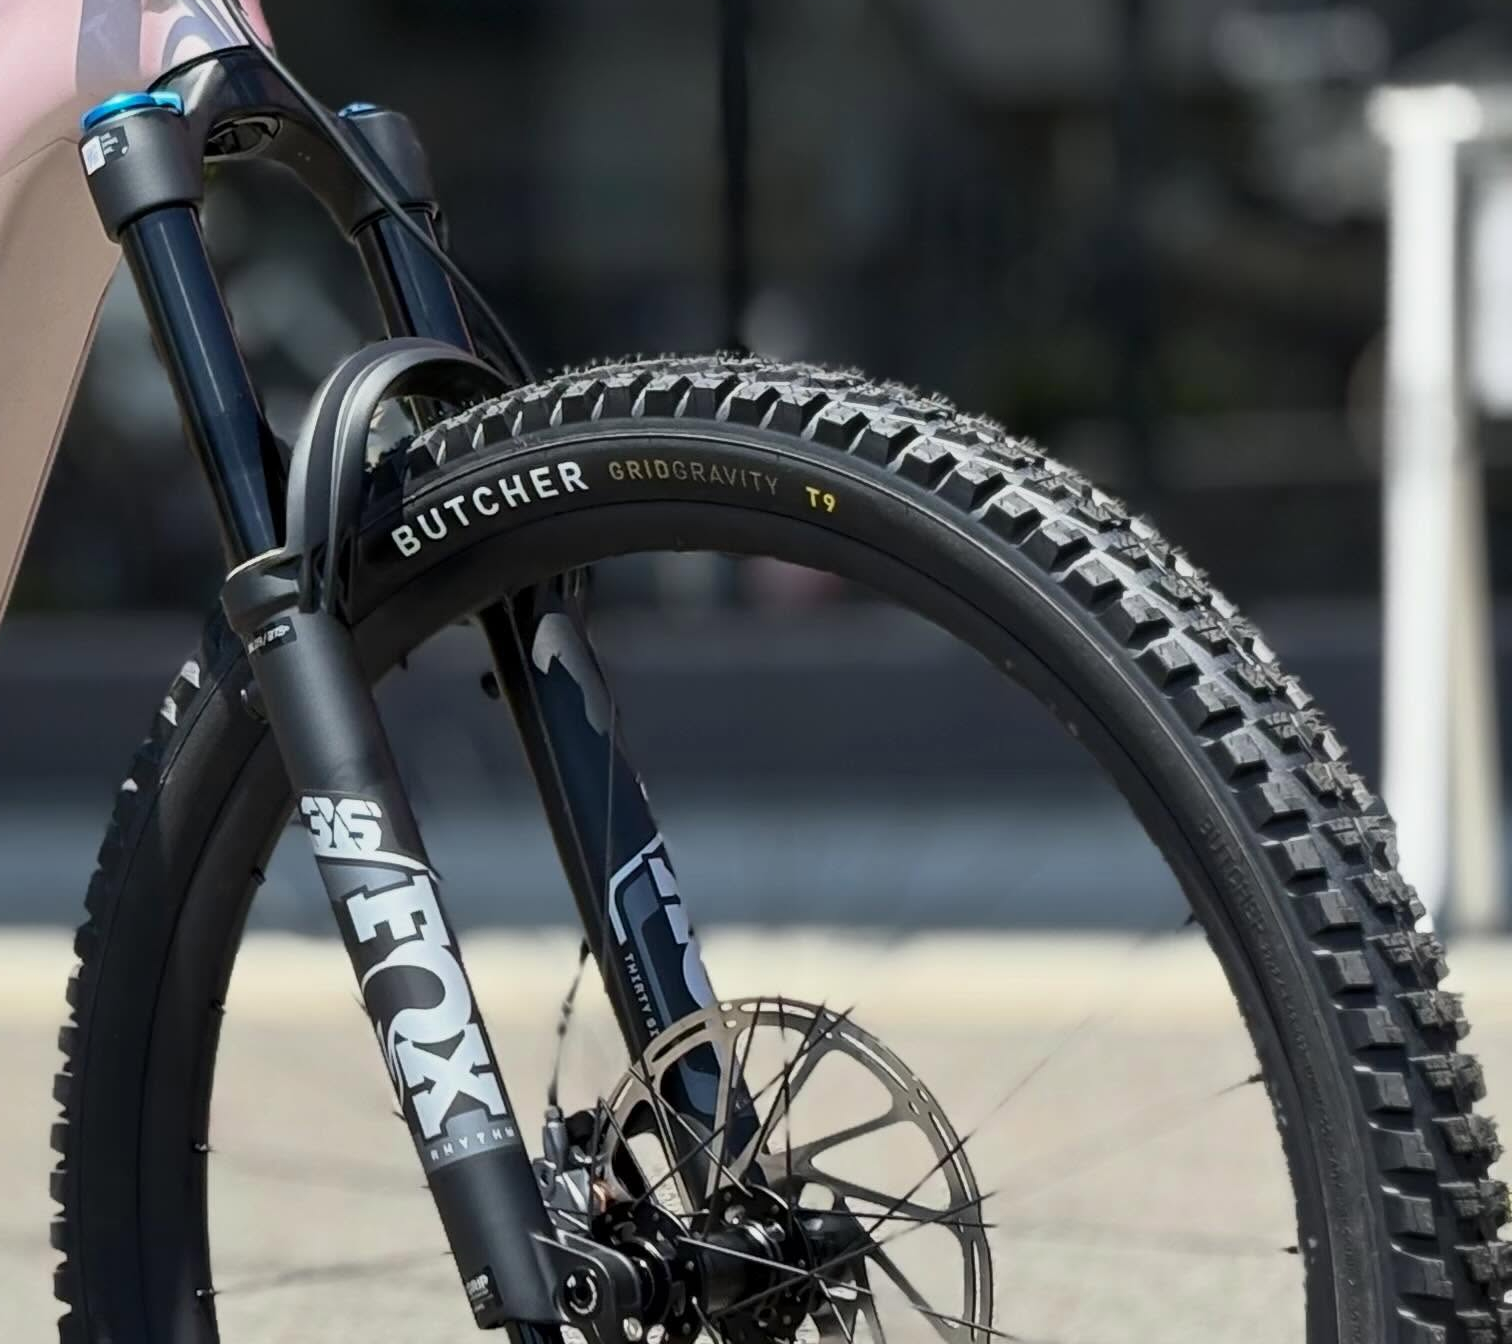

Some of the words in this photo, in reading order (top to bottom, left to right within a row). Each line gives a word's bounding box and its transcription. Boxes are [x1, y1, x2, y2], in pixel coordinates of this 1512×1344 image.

[391, 461, 590, 557] BUTCHER
[608, 459, 779, 496] GRIDGRAVITY
[805, 486, 836, 513] T9
[300, 796, 383, 854] 36
[346, 873, 508, 1141] FOX
[624, 952, 653, 1013] THIRTY
